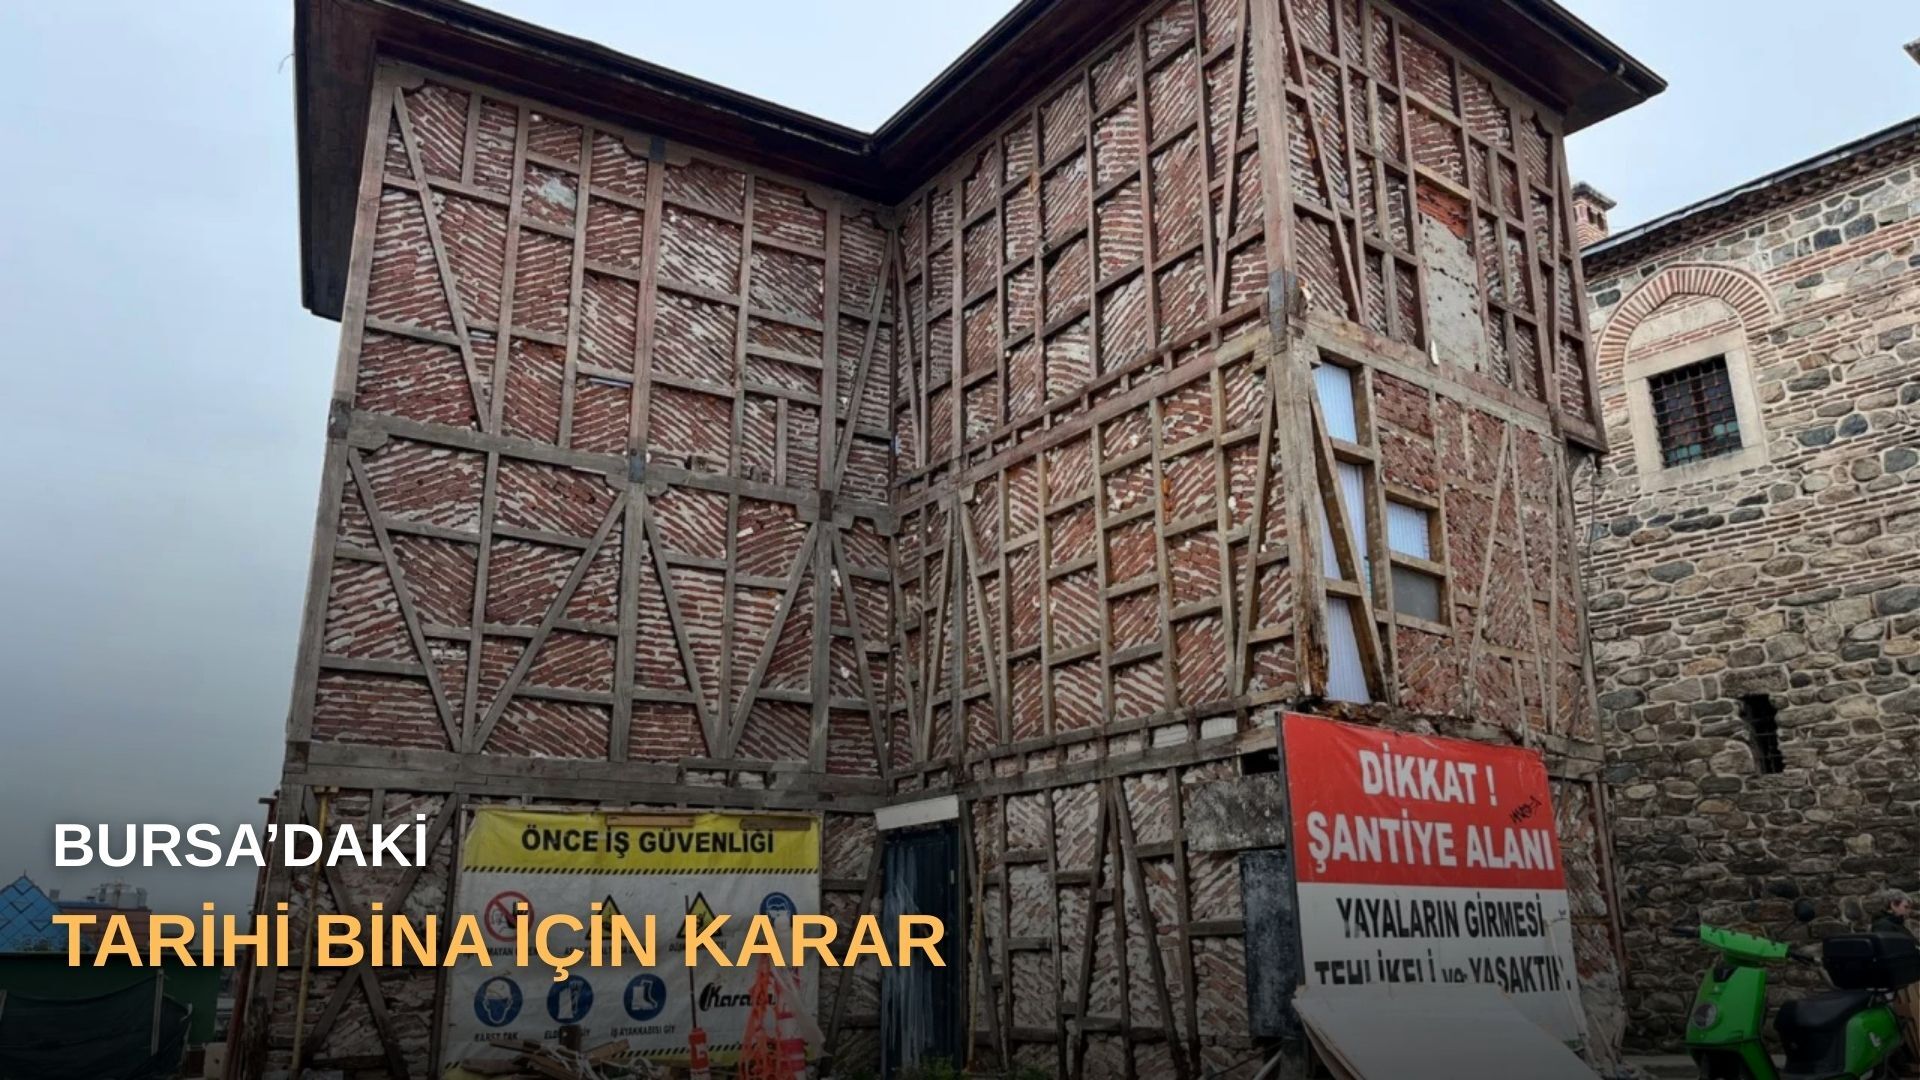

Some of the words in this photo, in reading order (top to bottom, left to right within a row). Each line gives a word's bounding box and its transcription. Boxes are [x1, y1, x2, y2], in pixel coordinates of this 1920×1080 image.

[1359, 742, 1477, 805] DİKKAT
[1486, 765, 1498, 806] !
[521, 824, 598, 852] ÖNCE
[606, 827, 630, 858] İŞ
[639, 827, 774, 853] GÜVENLİĞİ
[1307, 808, 1457, 874] ŞANTİYE
[1466, 825, 1555, 871] ALANI
[1336, 897, 1460, 939] YAYALARIN
[1464, 891, 1545, 938] GİRMESİ
